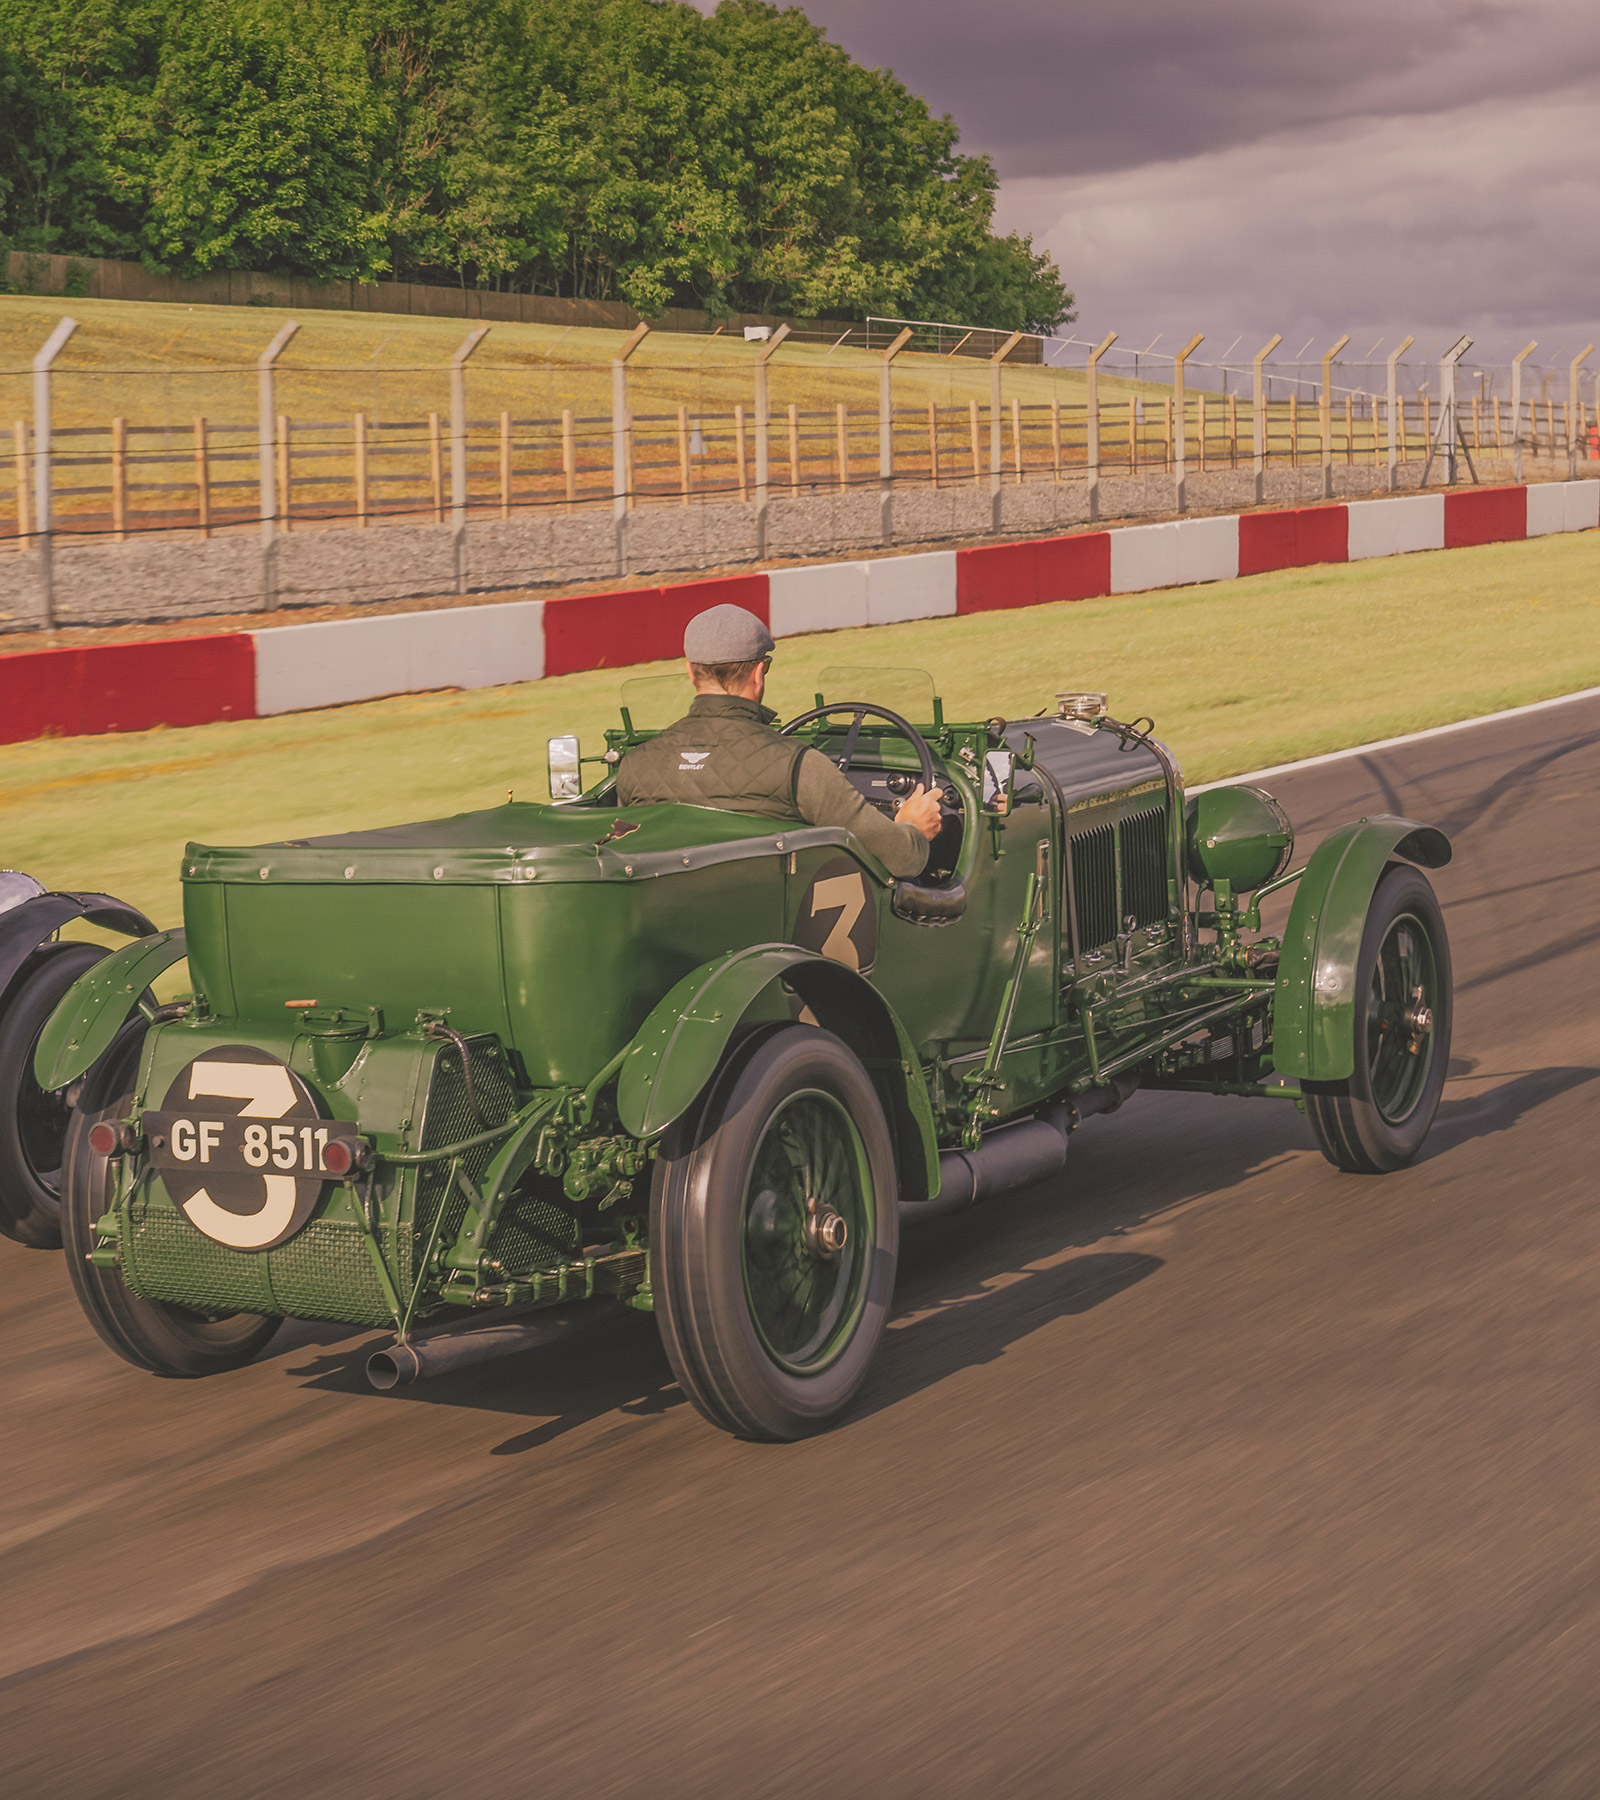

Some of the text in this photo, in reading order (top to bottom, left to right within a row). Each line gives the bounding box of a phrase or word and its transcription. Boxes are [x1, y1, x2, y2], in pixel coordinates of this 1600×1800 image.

[171, 1119, 329, 1171] GF 8511
[182, 1061, 298, 1248] 3
